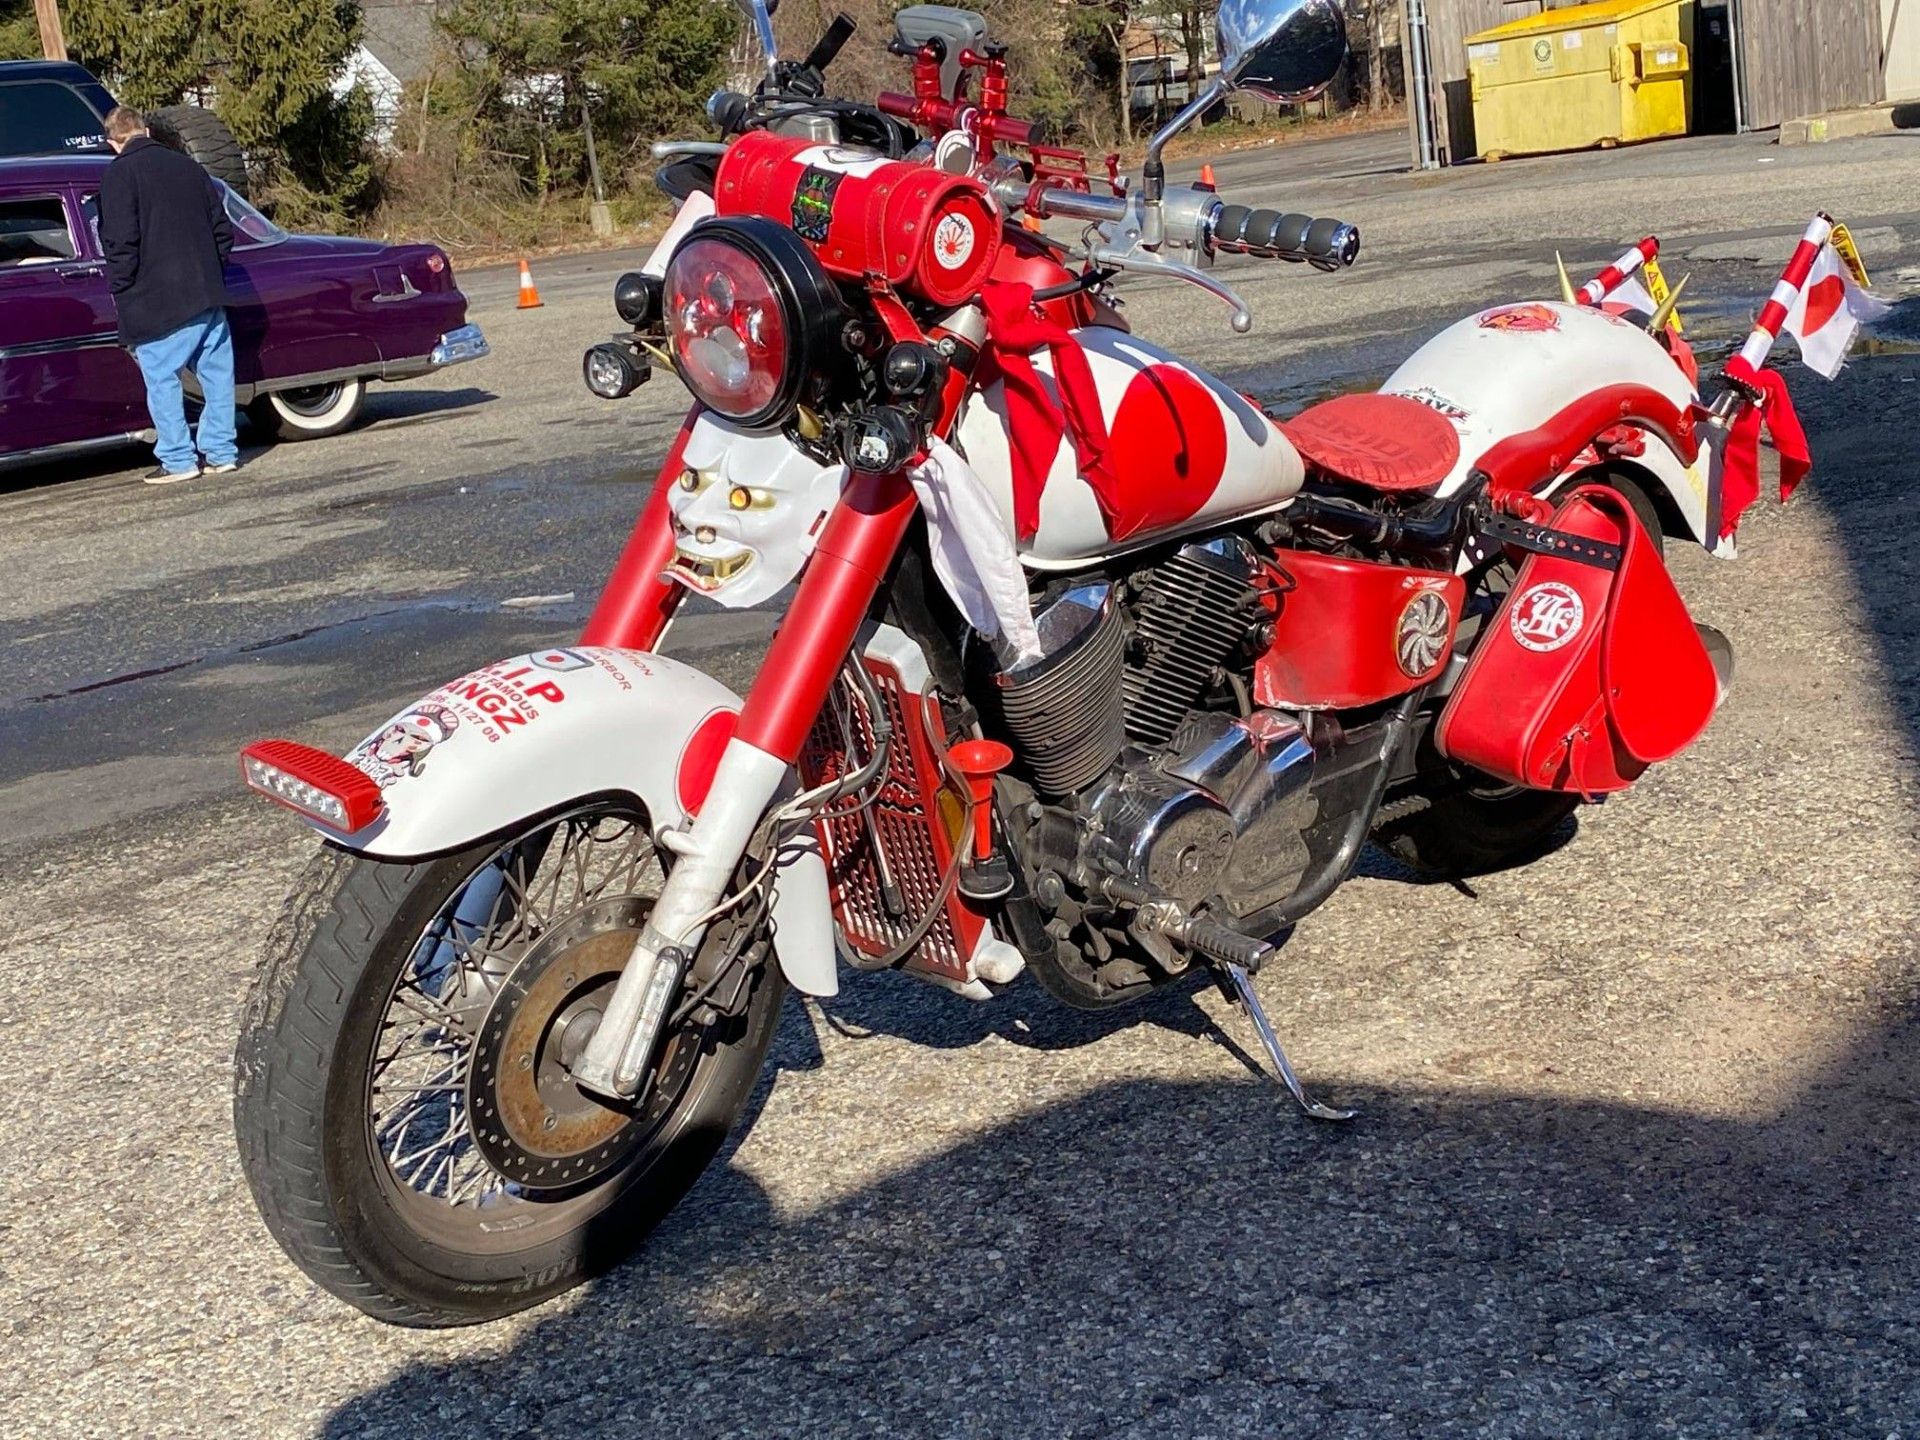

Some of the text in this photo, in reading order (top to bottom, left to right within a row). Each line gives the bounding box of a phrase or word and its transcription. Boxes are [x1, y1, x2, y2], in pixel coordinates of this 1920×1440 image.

[485, 677, 541, 721] FAMOUS
[452, 702, 487, 726] 11/27
[481, 726, 501, 743] 08
